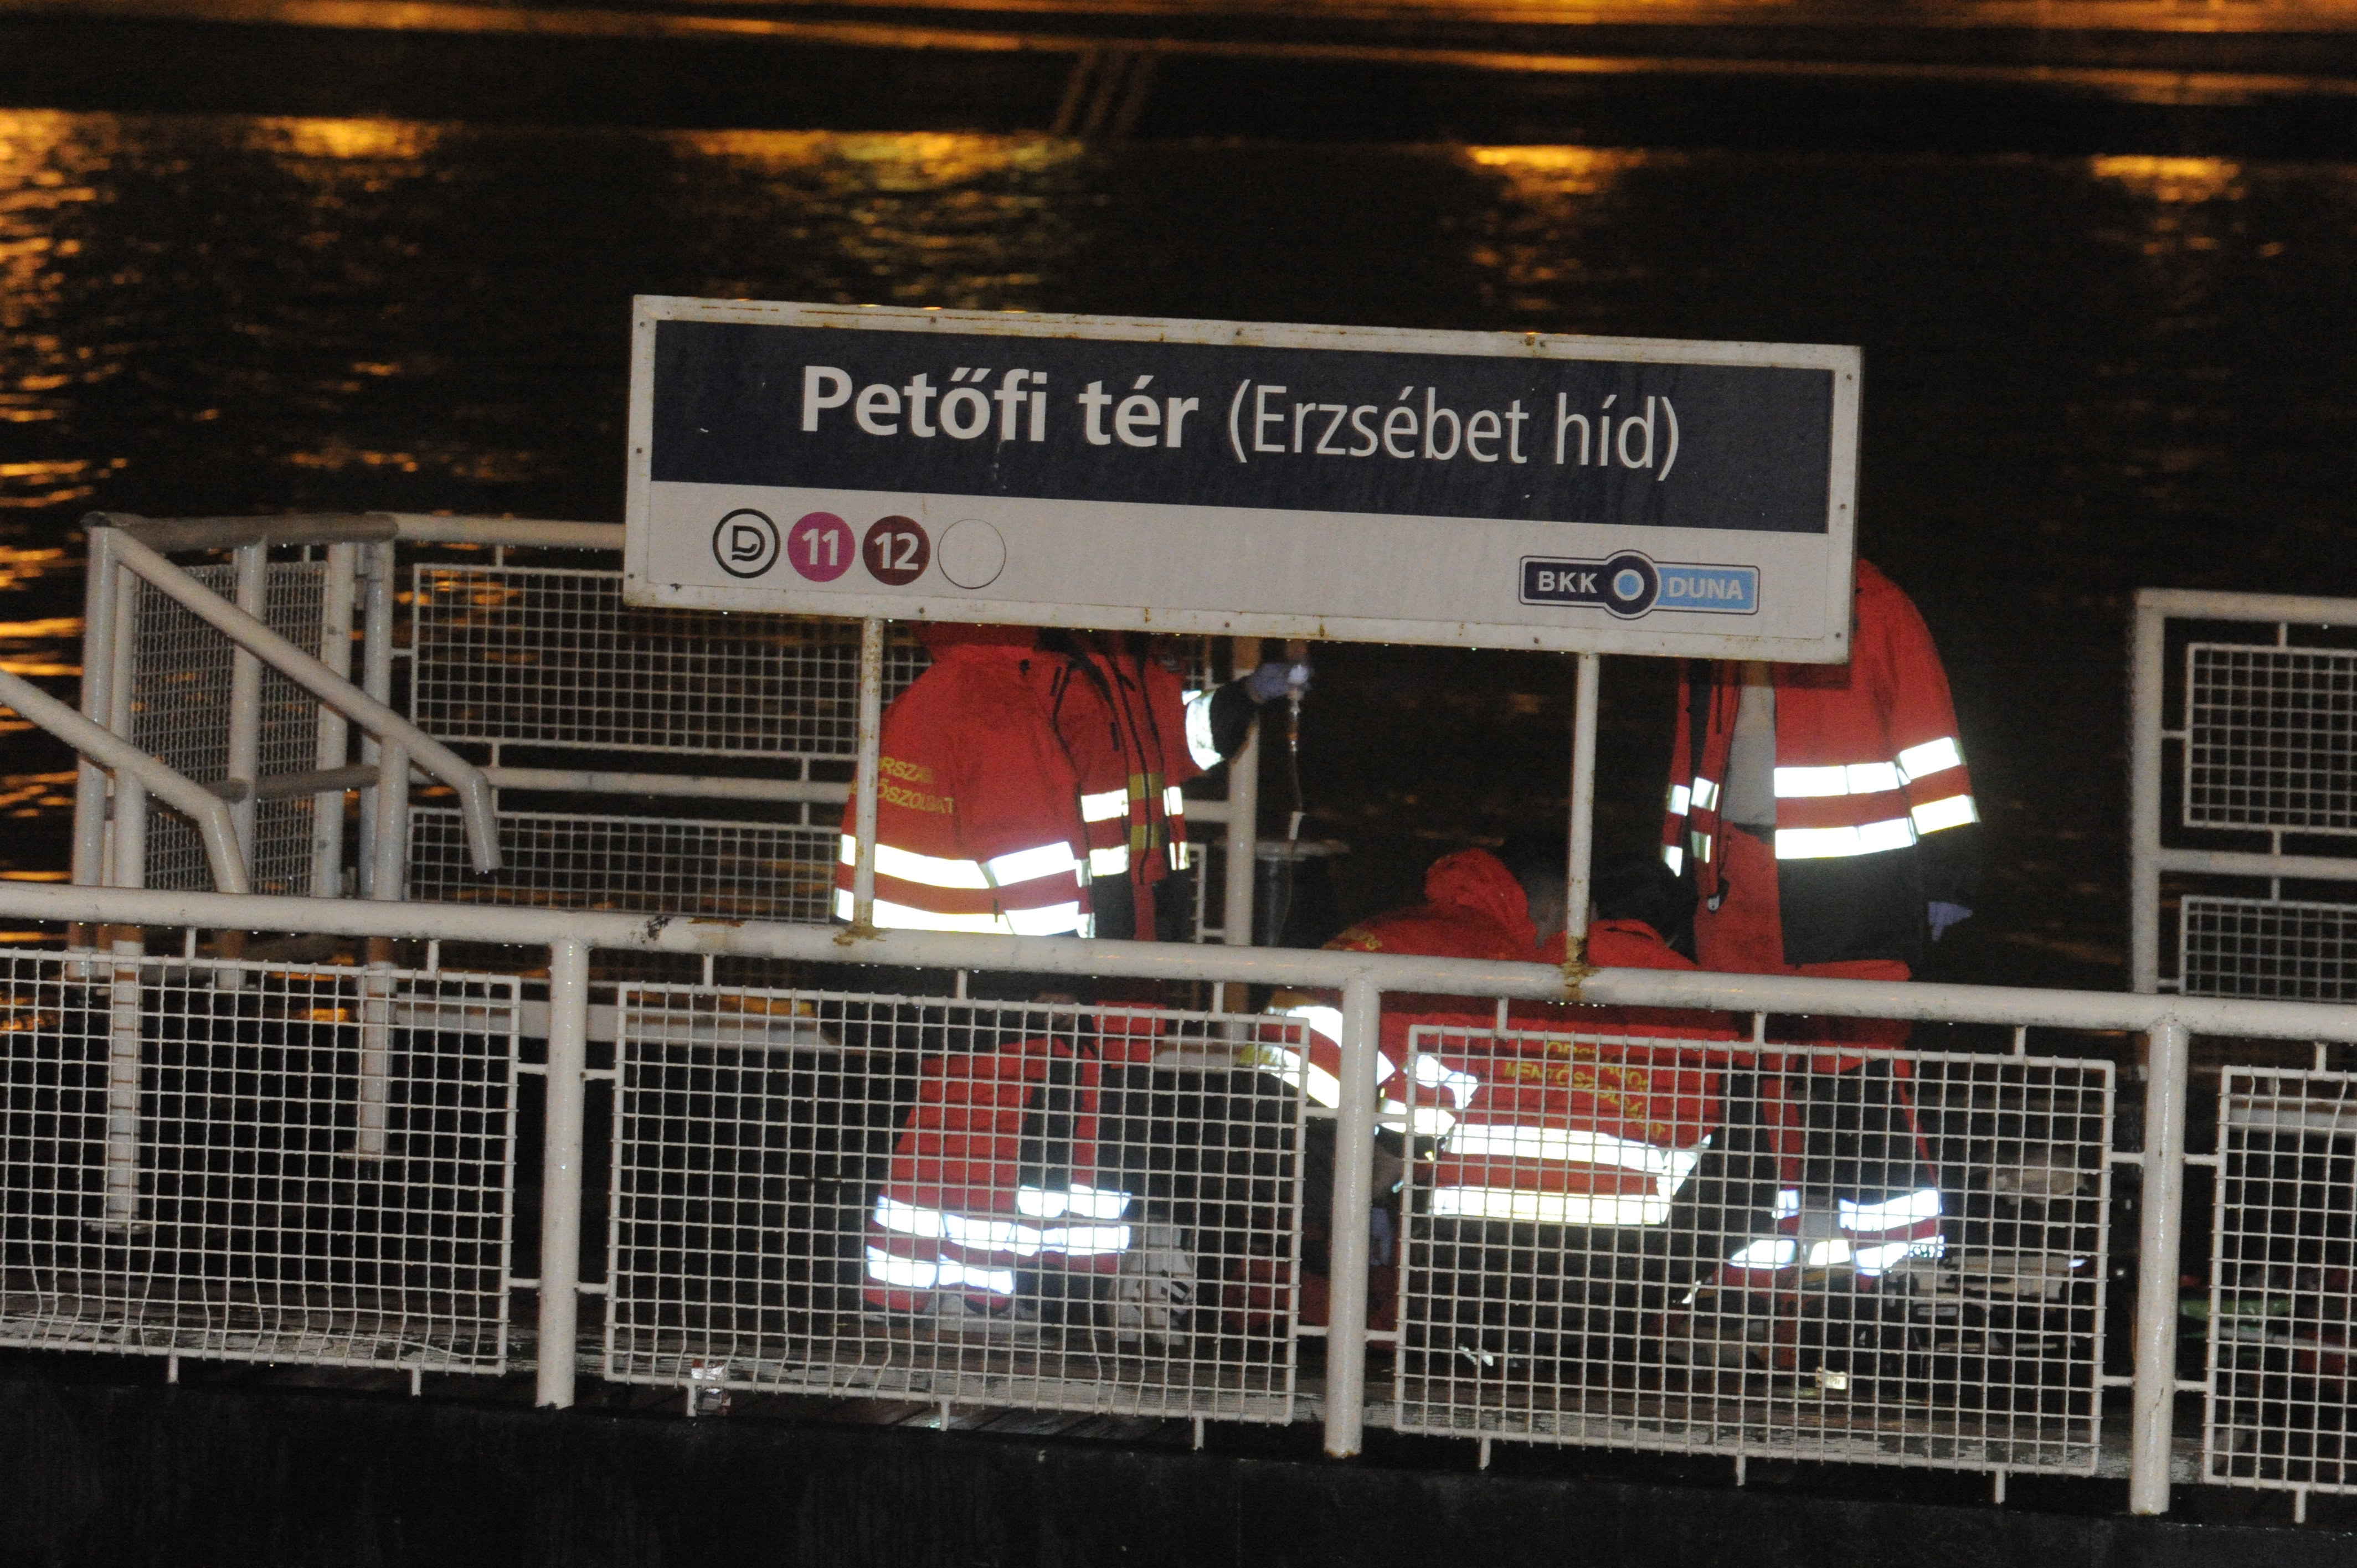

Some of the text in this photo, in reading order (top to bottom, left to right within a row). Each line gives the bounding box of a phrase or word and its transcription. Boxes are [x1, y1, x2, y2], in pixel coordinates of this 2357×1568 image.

[801, 365, 1680, 482] Petőfi tér (Erzsébet híd)
[801, 528, 840, 566] 11
[874, 532, 919, 571] 12
[1537, 570, 1744, 600] BKK DUNA
